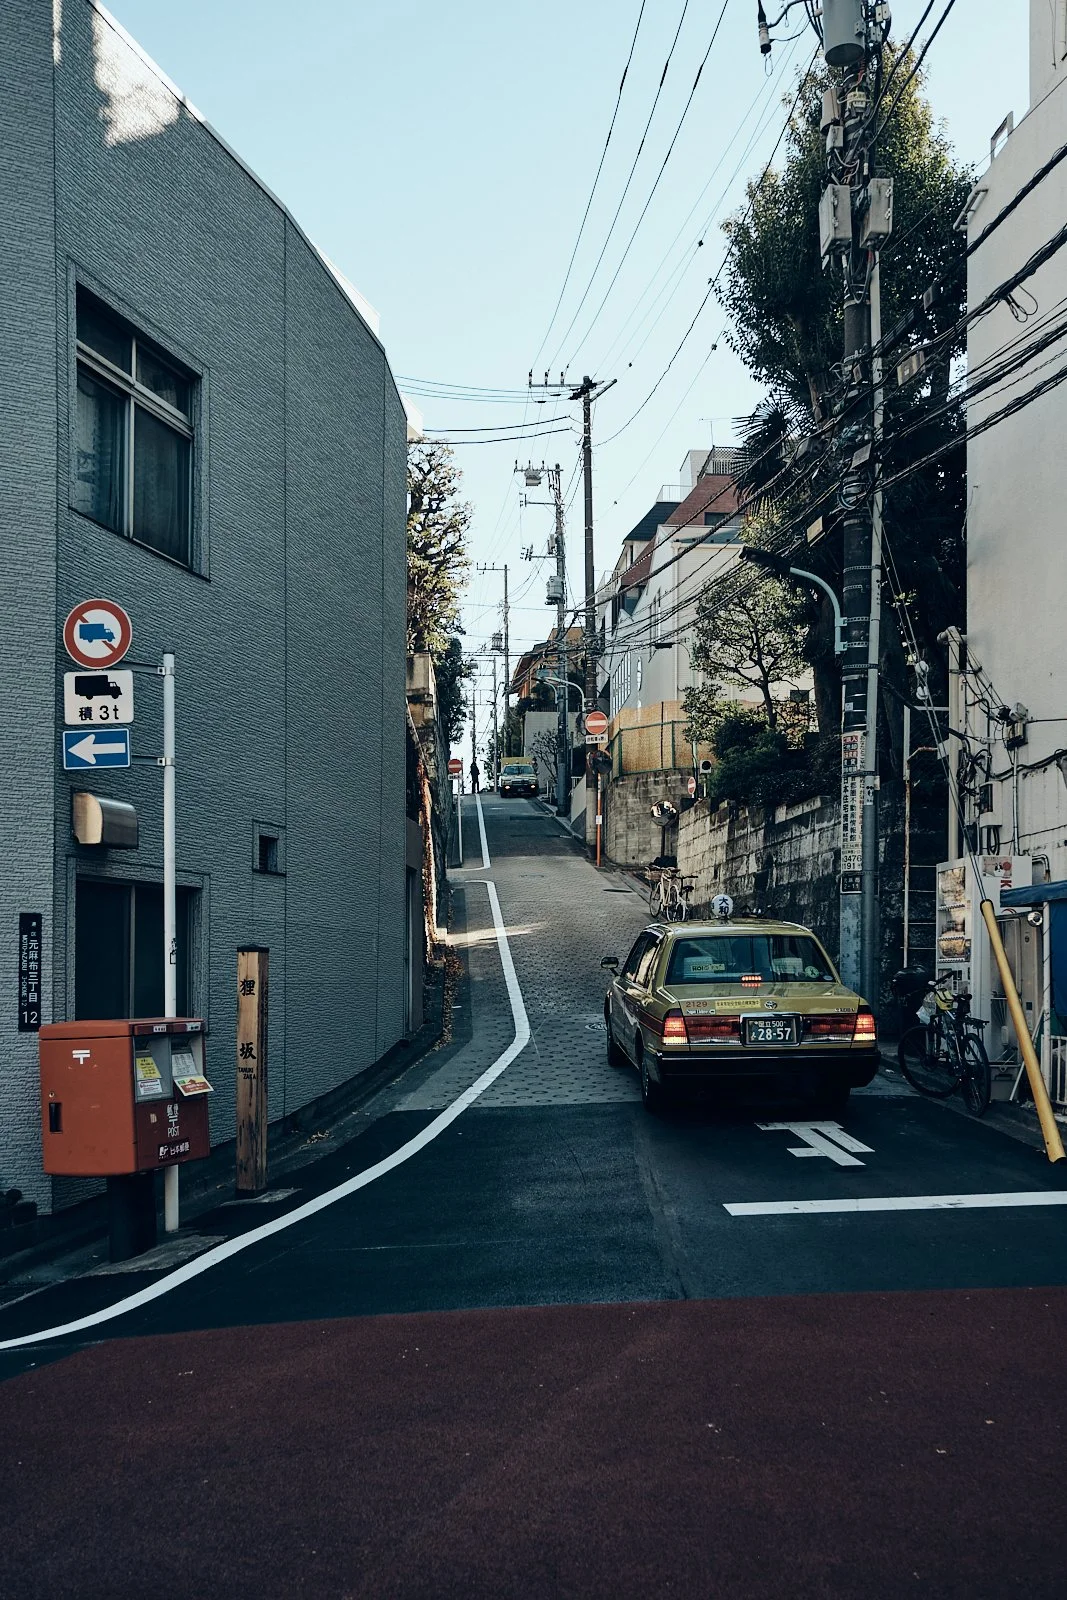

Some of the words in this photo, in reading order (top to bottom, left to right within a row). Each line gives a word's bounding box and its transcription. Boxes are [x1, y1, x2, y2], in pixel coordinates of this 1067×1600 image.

[718, 897, 730, 915] 大和
[22, 1010, 38, 1024] 12
[757, 1027, 792, 1041] 28-57
[167, 1126, 180, 1138] POST
